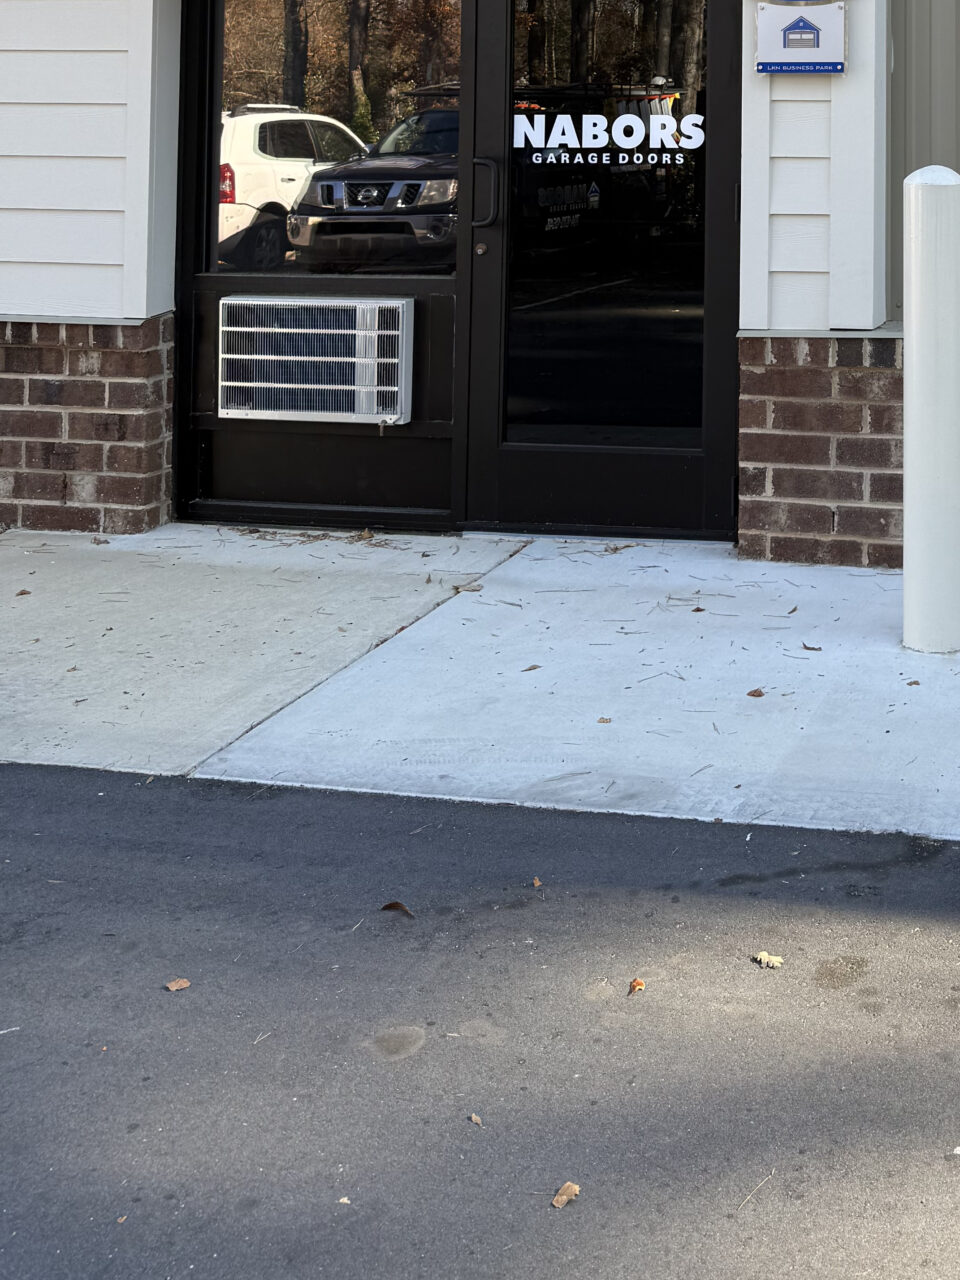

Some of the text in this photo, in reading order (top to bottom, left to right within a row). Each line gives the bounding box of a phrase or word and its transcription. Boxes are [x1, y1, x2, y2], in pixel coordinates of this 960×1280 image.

[513, 113, 705, 150] NABORS
[532, 153, 685, 165] GARAGE DOORS
